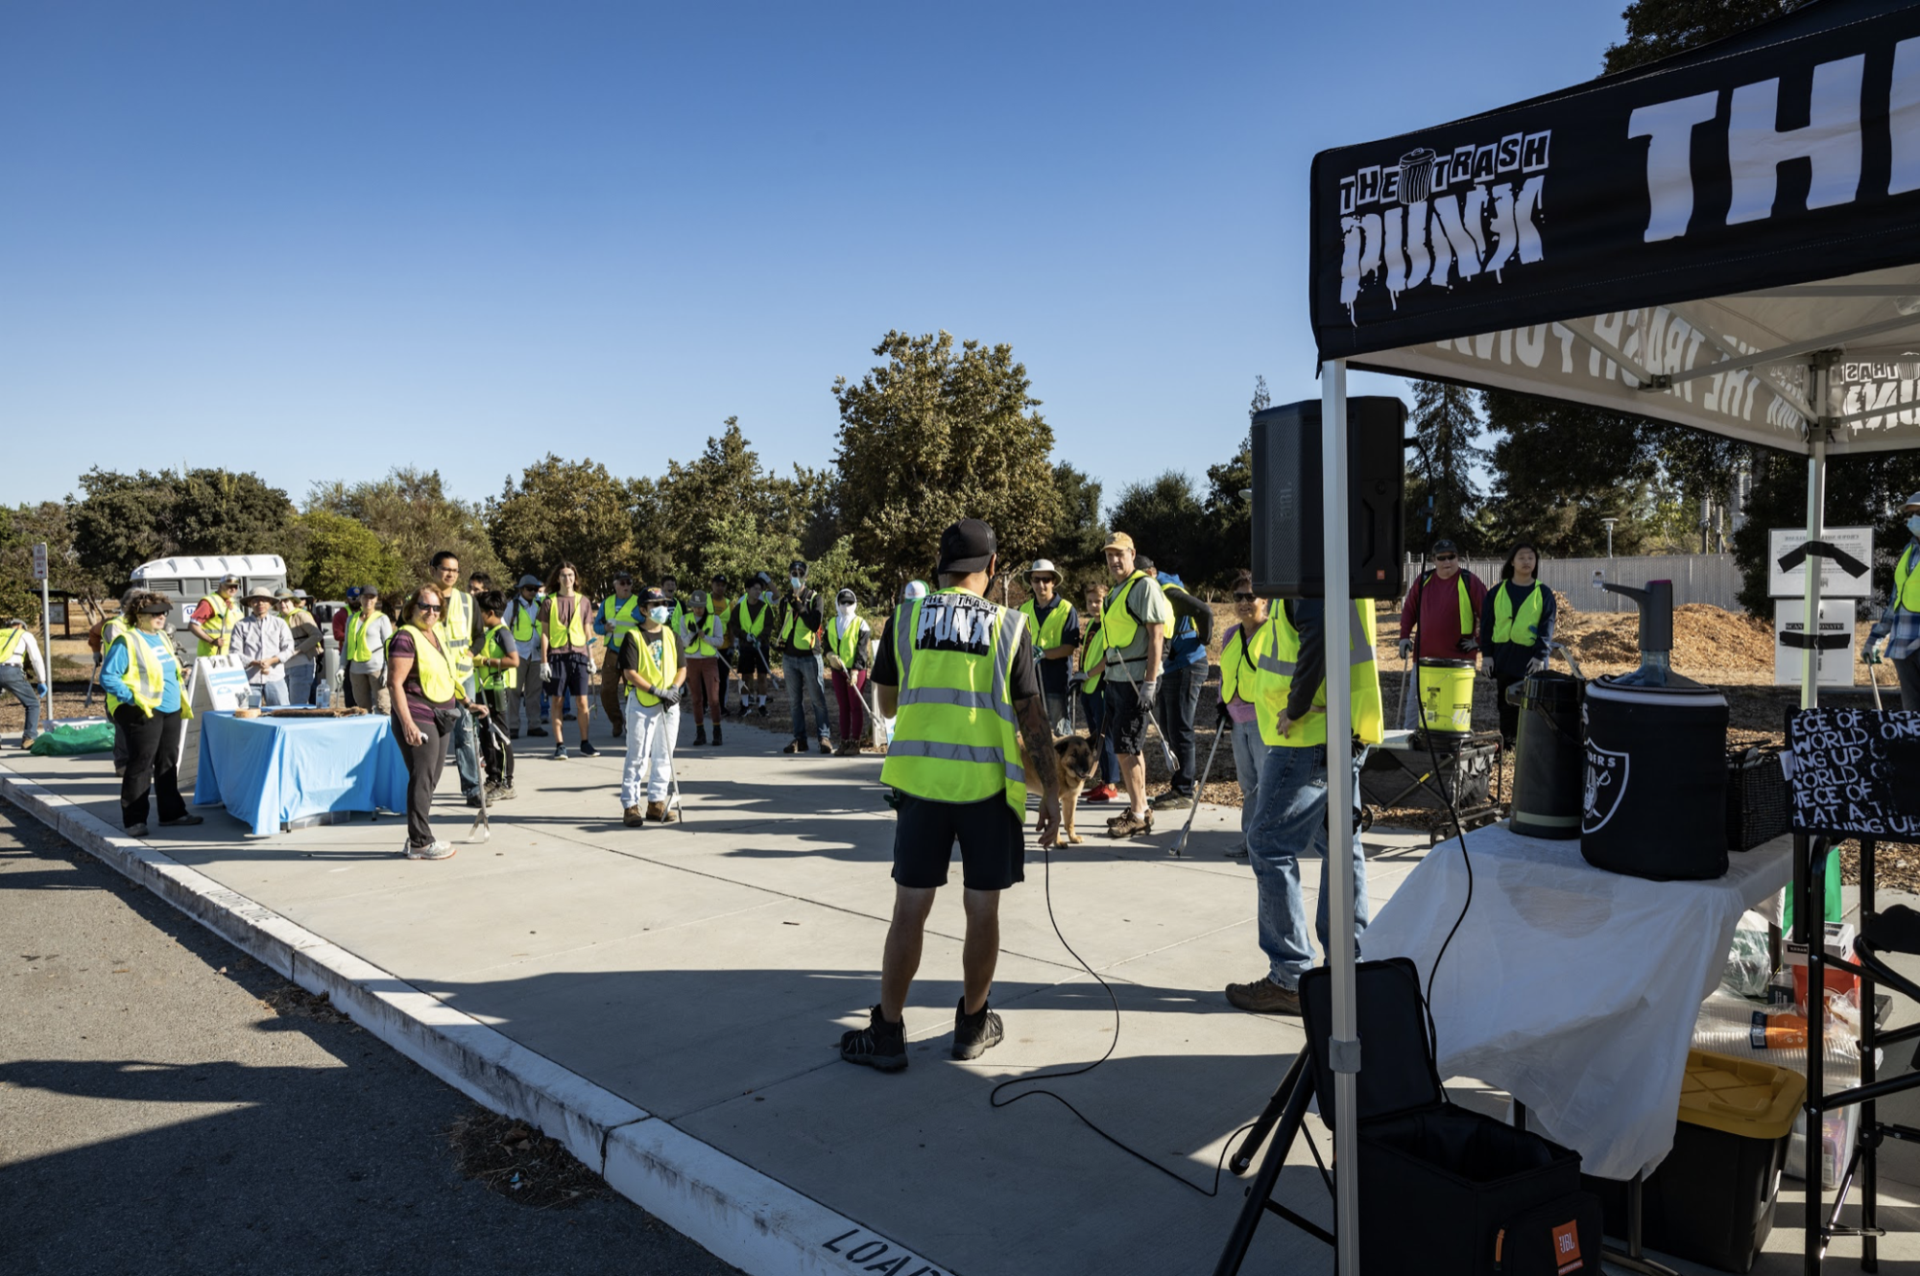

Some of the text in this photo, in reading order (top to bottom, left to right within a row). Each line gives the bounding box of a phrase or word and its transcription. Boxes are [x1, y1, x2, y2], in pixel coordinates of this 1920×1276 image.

[1340, 129, 1552, 214] THE TRASH
[922, 594, 999, 614] THE TRASH
[1837, 710, 1863, 728] OF
[1831, 746, 1864, 766] UP
[1845, 777, 1873, 800] OF
[1558, 1232, 1576, 1254] JBL
